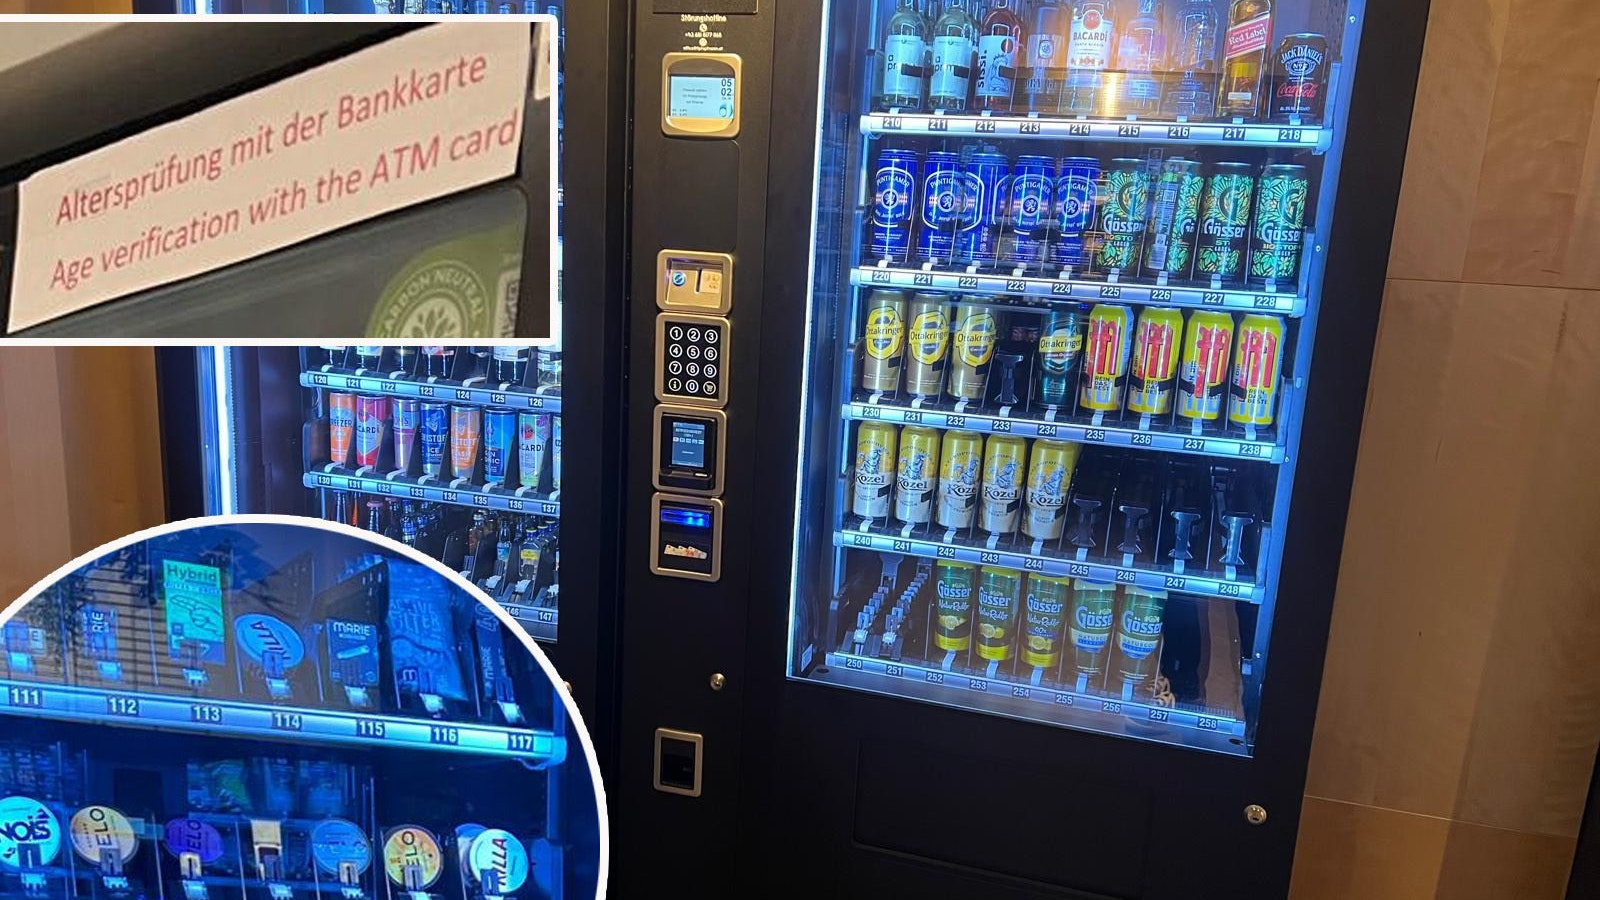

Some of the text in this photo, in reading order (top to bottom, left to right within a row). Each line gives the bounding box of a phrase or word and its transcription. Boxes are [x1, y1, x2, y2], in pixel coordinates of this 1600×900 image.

[1228, 35, 1246, 45] Red
[1245, 27, 1266, 41] Label
[1281, 48, 1298, 64] JACK
[721, 78, 732, 87] 05
[721, 88, 732, 96] 02
[884, 118, 901, 128] 210
[929, 119, 947, 129] 211
[977, 120, 994, 130] 212
[1021, 122, 1040, 132] 213
[1071, 125, 1091, 135] 214
[1120, 126, 1139, 136] 215
[1170, 127, 1188, 137] 216
[1225, 129, 1244, 138] 217
[56, 54, 487, 225] Altersprüfung mit der Bankkarte
[1280, 130, 1300, 140] 218
[50, 108, 518, 290] Age verification with the ATM card
[874, 272, 890, 281] 220
[916, 274, 932, 284] 221
[959, 277, 977, 287] 222
[1008, 281, 1025, 290] 223
[434, 267, 487, 318] NEUTRAL
[1053, 284, 1071, 293] 224
[1102, 287, 1119, 297] 225
[1152, 290, 1170, 300] 226
[1204, 293, 1224, 303] 227
[1256, 296, 1276, 307] 228
[673, 330, 679, 338] 1
[691, 331, 697, 340] 2
[708, 332, 714, 340] 3
[1040, 336, 1081, 350] Ottakringer
[673, 347, 679, 355] 4
[690, 348, 696, 357] 5
[707, 350, 714, 358] 6
[672, 364, 678, 372] 7
[690, 366, 696, 374] 8
[707, 367, 713, 375] 9
[347, 379, 359, 387] 121
[382, 383, 394, 391] 122
[689, 382, 695, 391] 0
[420, 387, 433, 395] 123
[456, 391, 470, 399] 124
[491, 394, 505, 403] 125
[529, 398, 543, 407] 126
[864, 408, 880, 417] 230
[905, 412, 921, 421] 231
[948, 416, 964, 426] 232
[994, 421, 1010, 430] 233
[1040, 425, 1056, 435] 234
[1087, 430, 1103, 439] 235
[1133, 435, 1151, 444] 236
[1185, 440, 1203, 449] 237
[1242, 445, 1259, 454] 238
[318, 477, 331, 485] 130
[348, 481, 361, 489] 131
[898, 477, 928, 491] Kozel
[377, 484, 390, 493] 132
[411, 488, 424, 496] 133
[983, 485, 1018, 501] Kozel
[443, 492, 456, 501] 134
[474, 496, 487, 505] 135
[1030, 493, 1065, 507] Kozel
[509, 500, 523, 509] 136
[543, 504, 555, 513] 137
[855, 537, 870, 546] 240
[895, 542, 910, 551] 241
[938, 548, 955, 557] 242
[982, 553, 998, 563] 243
[1026, 559, 1042, 569] 244
[167, 564, 217, 582] Hybrid
[1072, 566, 1088, 575] 245
[1118, 571, 1134, 581] 246
[1167, 578, 1184, 587] 247
[938, 580, 971, 599] Gösser
[1220, 584, 1238, 594] 248
[979, 587, 1011, 607] Gösser
[1027, 593, 1063, 613] Gösser
[507, 607, 519, 616] 146
[539, 612, 552, 621] 147
[847, 660, 862, 669] 250
[887, 666, 902, 675] 251
[927, 672, 943, 682] 252
[971, 680, 987, 690] 253
[11, 688, 40, 705] 111
[1013, 687, 1029, 697] 254
[1056, 695, 1073, 704] 255
[109, 698, 137, 713] 112
[1104, 703, 1120, 712] 256
[193, 706, 220, 721] 113
[1150, 711, 1167, 720] 257
[274, 713, 300, 728] 114
[1199, 719, 1216, 728] 258
[359, 721, 384, 736] 115
[433, 727, 456, 742] 116
[510, 735, 533, 749] 117
